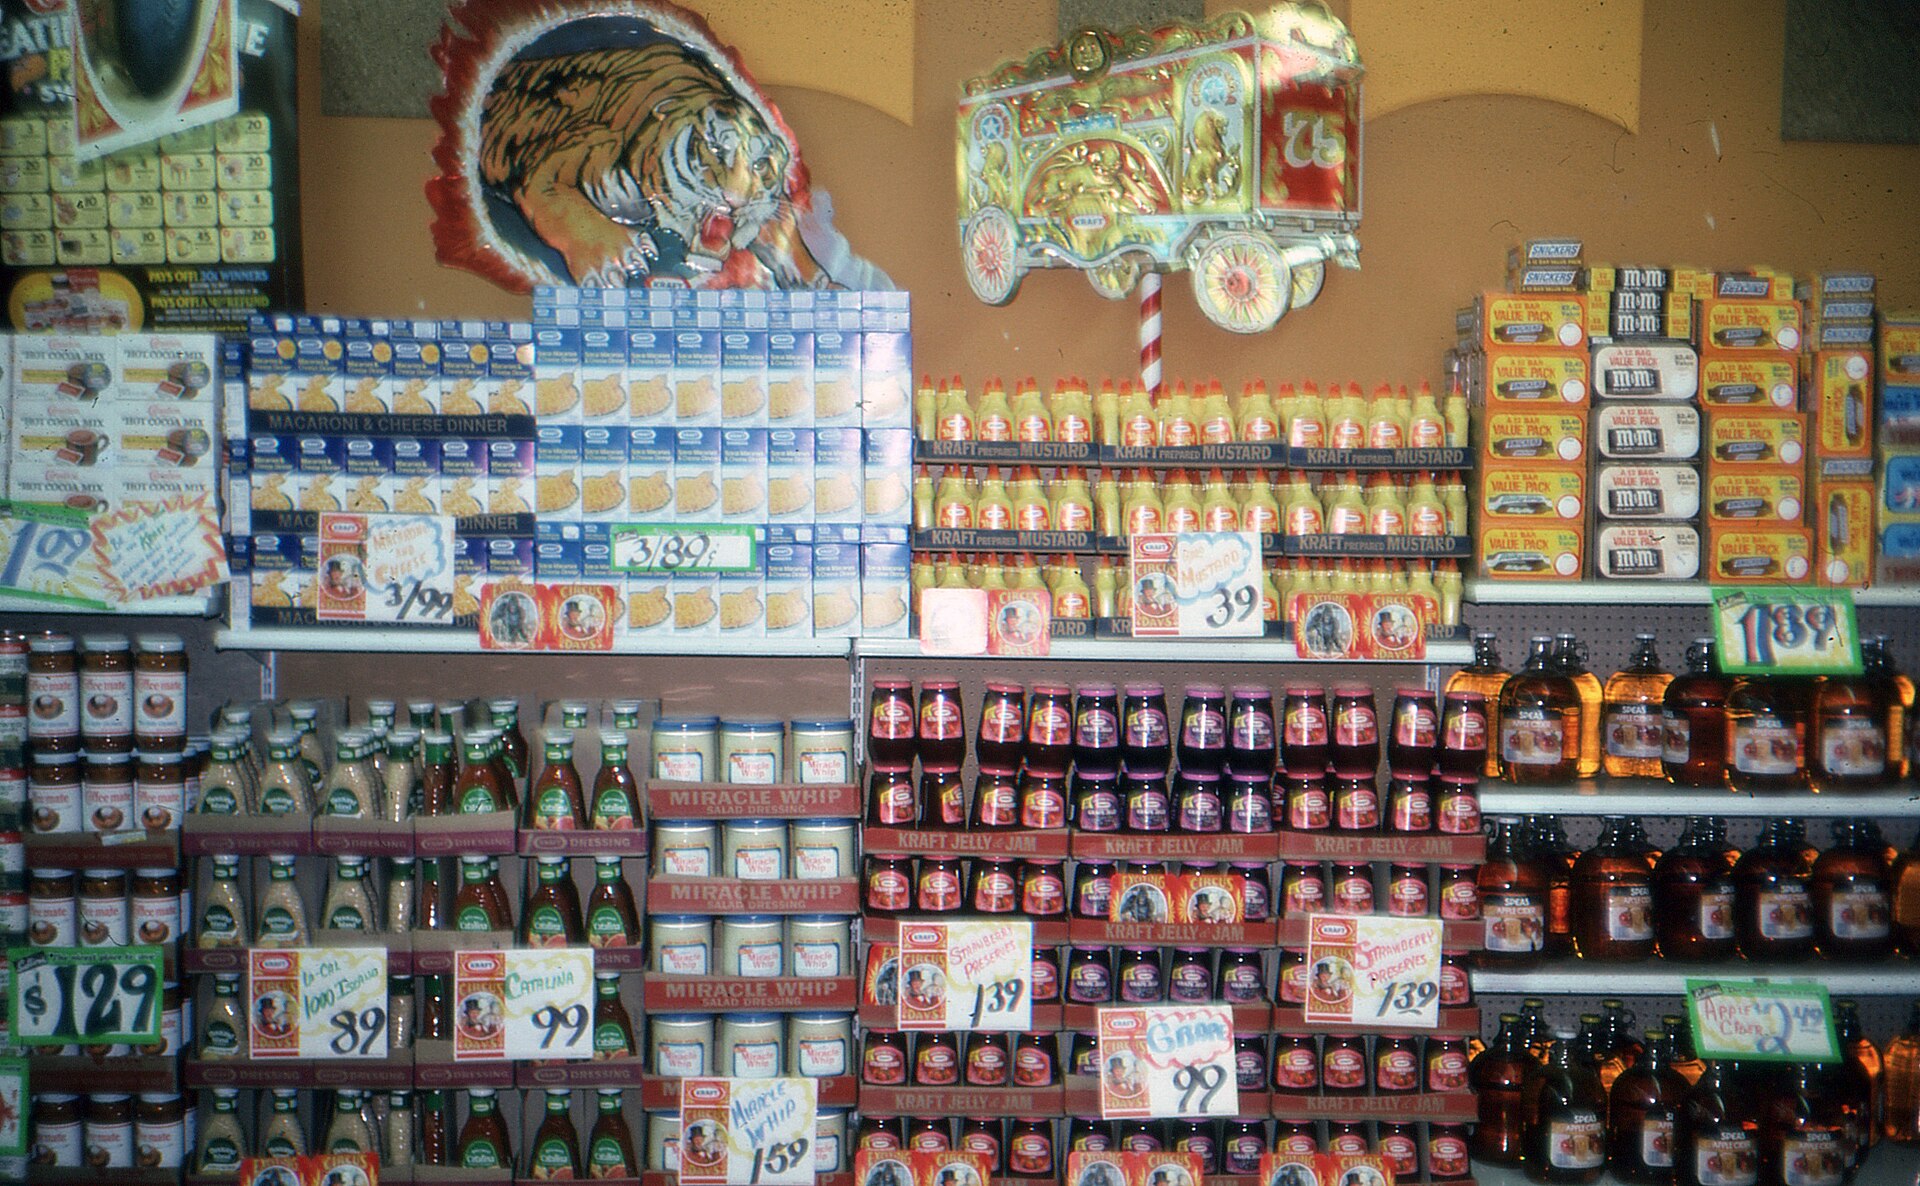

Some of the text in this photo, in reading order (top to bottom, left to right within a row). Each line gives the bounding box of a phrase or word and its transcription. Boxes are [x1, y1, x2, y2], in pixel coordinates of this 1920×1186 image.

[1073, 217, 1105, 226] KRAFT
[1531, 246, 1579, 256] SNICKERS
[1526, 272, 1574, 283] SNICKERS
[1493, 310, 1554, 322] VALUE PACK
[24, 350, 105, 361] HOT COCOA MIX
[124, 350, 204, 359] HOT COCOA MIX
[22, 417, 104, 427] HOT COCOA MIX
[122, 417, 204, 427] HOT COCOA MIX
[269, 415, 508, 432] MACARONI & CHEESE DINNER
[933, 441, 1089, 458] KRAFT PREPARED MUSTARD
[1115, 446, 1272, 460] KRAFT PREPARED MUSTARD
[1307, 448, 1464, 464] KRAFT PREPARED MUSTARD
[19, 482, 103, 492] HOT COCOA MIX
[123, 482, 205, 493] HOT COCOA MIX
[458, 516, 518, 530] DINNER
[932, 530, 1088, 547] KRAFT PREPARED MUSTARD
[1299, 536, 1456, 551] KRAFT PREPARED MUSTARD
[1144, 542, 1166, 550] KRAFT
[1136, 563, 1178, 576] CIRCUS
[385, 579, 453, 620] 3/99
[1206, 585, 1258, 628] 39
[1142, 618, 1171, 627] DAYS
[1735, 604, 1835, 666] 189
[1519, 711, 1544, 720] SPEAS
[1622, 706, 1646, 714] SPEAS
[814, 768, 837, 777] Whip
[670, 789, 842, 805] MIRACLE WHIP
[600, 804, 627, 813] Catalina
[706, 805, 806, 814] SALAD DRESSING
[898, 834, 946, 848] KRAFT
[951, 835, 992, 849] JELLY
[1005, 836, 1037, 851] JAM
[1105, 838, 1152, 853] KRAFT
[1158, 838, 1197, 853] JELLY
[1212, 838, 1244, 852] JAM
[1315, 838, 1363, 853] KRAFT
[1367, 838, 1409, 853] JELLY
[1422, 839, 1452, 854] JAM
[749, 864, 772, 874] Whip
[803, 864, 826, 872] Whip
[1190, 876, 1233, 889] CIRCUS
[671, 885, 842, 900] MIRACLE WHIP
[707, 901, 806, 909] SALAD DRESSING
[1504, 898, 1530, 906] SPEAS
[593, 922, 622, 931] Catalina
[1105, 923, 1152, 938] KRAFT
[1158, 924, 1197, 939] JELLY
[1212, 926, 1244, 941] JAM
[1355, 929, 1435, 970] STRAWBERRY
[804, 959, 828, 968] Whip
[1367, 954, 1428, 989] PRESERVES
[505, 970, 574, 1000] CATALINA
[665, 982, 838, 998] MIRACLE WHIP
[702, 998, 801, 1007] SALAD DRESSING
[971, 979, 1025, 1028] 139
[1377, 981, 1438, 1017] 139
[330, 1007, 386, 1054] 89
[532, 1004, 589, 1049] 99
[596, 1039, 624, 1047] Catalina
[571, 1070, 630, 1078] DRESSING
[1173, 1064, 1228, 1113] 99
[896, 1095, 944, 1109] KRAFT
[948, 1095, 989, 1110] JELLY
[1002, 1096, 1032, 1110] JAM
[1307, 1096, 1355, 1110] KRAFT
[1360, 1097, 1400, 1111] JELLY
[1413, 1097, 1446, 1112] JAM
[1720, 1132, 1745, 1140] SPEAS
[1807, 1133, 1831, 1141] SPEAS
[750, 1138, 809, 1185] 159
